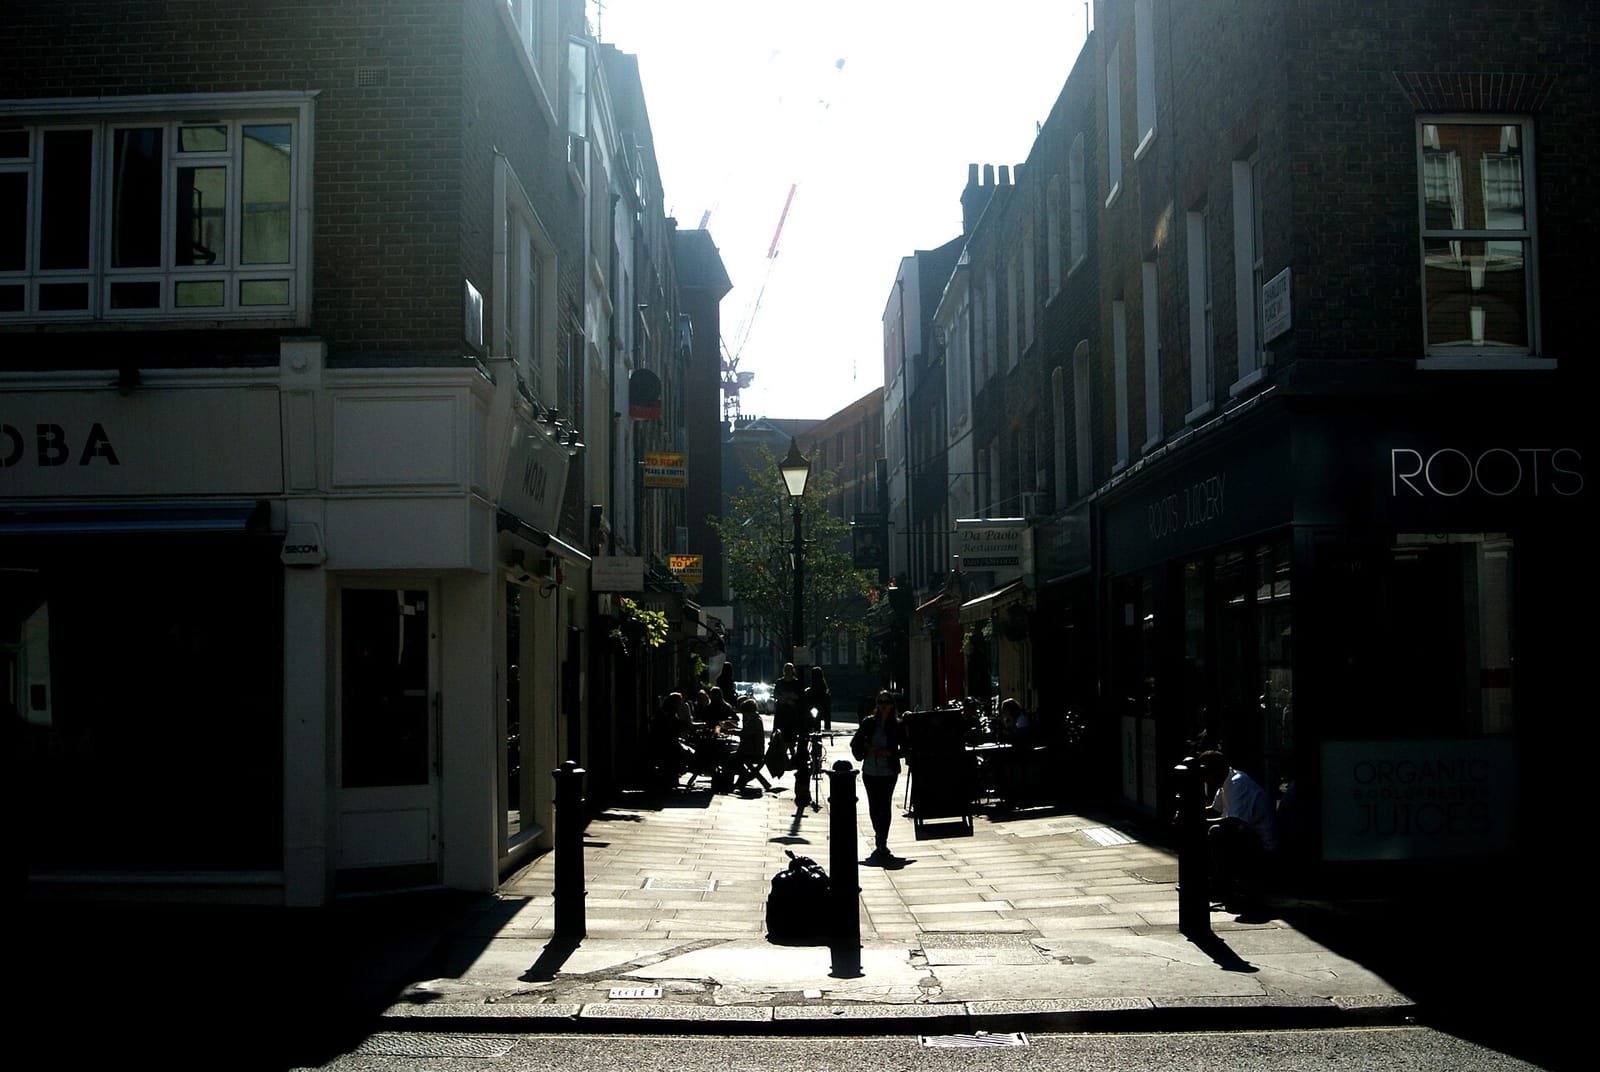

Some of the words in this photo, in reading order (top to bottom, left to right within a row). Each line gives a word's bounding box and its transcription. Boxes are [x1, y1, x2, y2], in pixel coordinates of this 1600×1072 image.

[645, 458, 658, 466] TO
[1391, 448, 1584, 496] ROOTS
[1149, 494, 1178, 539] ROOTS
[1184, 472, 1226, 528] JUICERY
[961, 530, 980, 541] Da
[983, 529, 1018, 541] Paolo
[962, 543, 1018, 552] Restaurant
[1353, 760, 1489, 784] ORGANIC
[1354, 802, 1491, 836] JUICES
